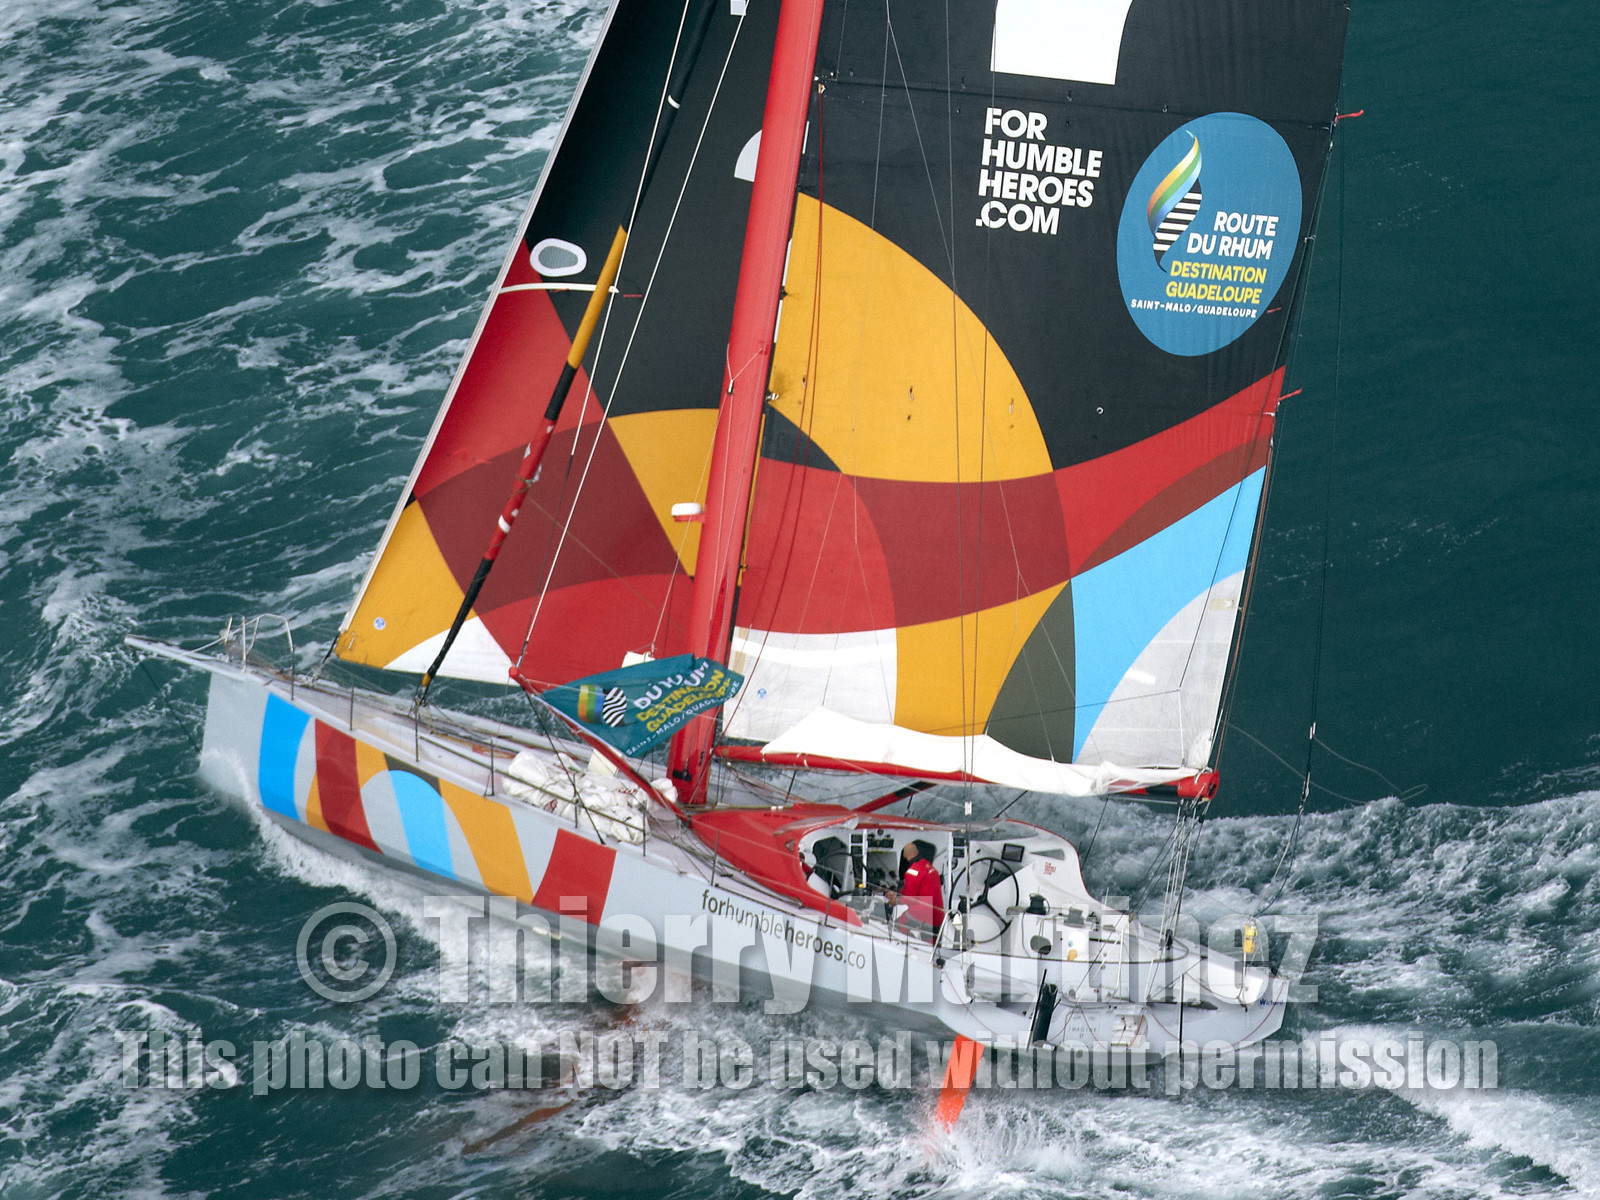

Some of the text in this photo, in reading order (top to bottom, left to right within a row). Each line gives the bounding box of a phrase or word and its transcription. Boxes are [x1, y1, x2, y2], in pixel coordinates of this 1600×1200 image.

[984, 107, 1048, 141] FOR
[981, 138, 1103, 178] HUMBLE
[978, 168, 1095, 208] HEROES
[975, 200, 1060, 236] .COM
[1213, 211, 1279, 237] ROUTE
[1186, 232, 1274, 260] DU RHUM
[1170, 260, 1267, 284] DESTINATION
[1165, 281, 1263, 304] GUADELOUPE
[633, 684, 663, 710] DU
